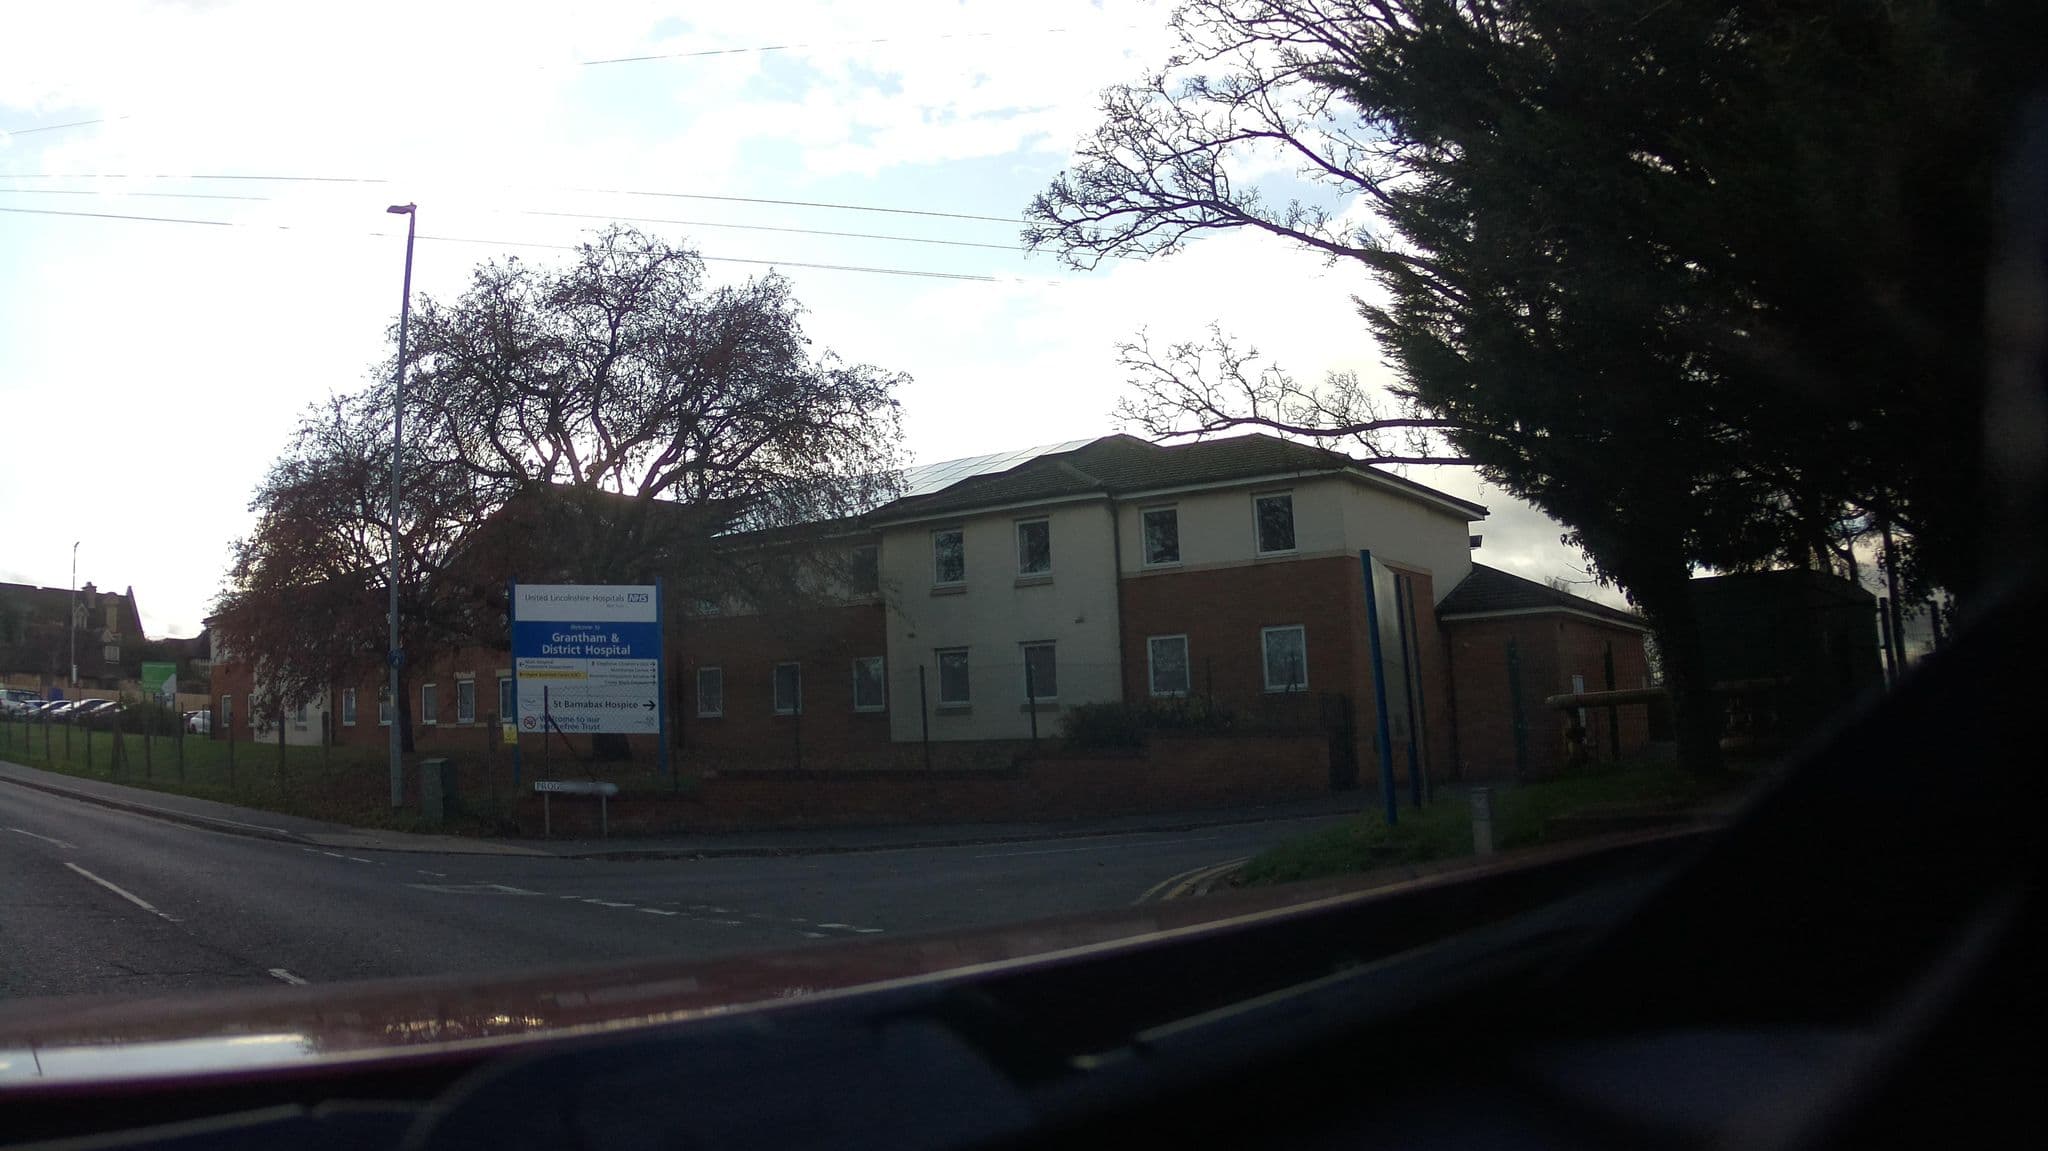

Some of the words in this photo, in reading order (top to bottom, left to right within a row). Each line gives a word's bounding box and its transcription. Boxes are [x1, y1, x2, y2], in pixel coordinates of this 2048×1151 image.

[593, 593, 624, 604] Hospitals
[628, 594, 648, 602] NHS
[552, 632, 607, 643] Grantham
[611, 633, 620, 642] &
[542, 644, 581, 655] District
[586, 644, 631, 656] Hospital
[553, 699, 561, 708] St
[564, 699, 603, 708] Barnabas
[605, 699, 638, 710] Hospice
